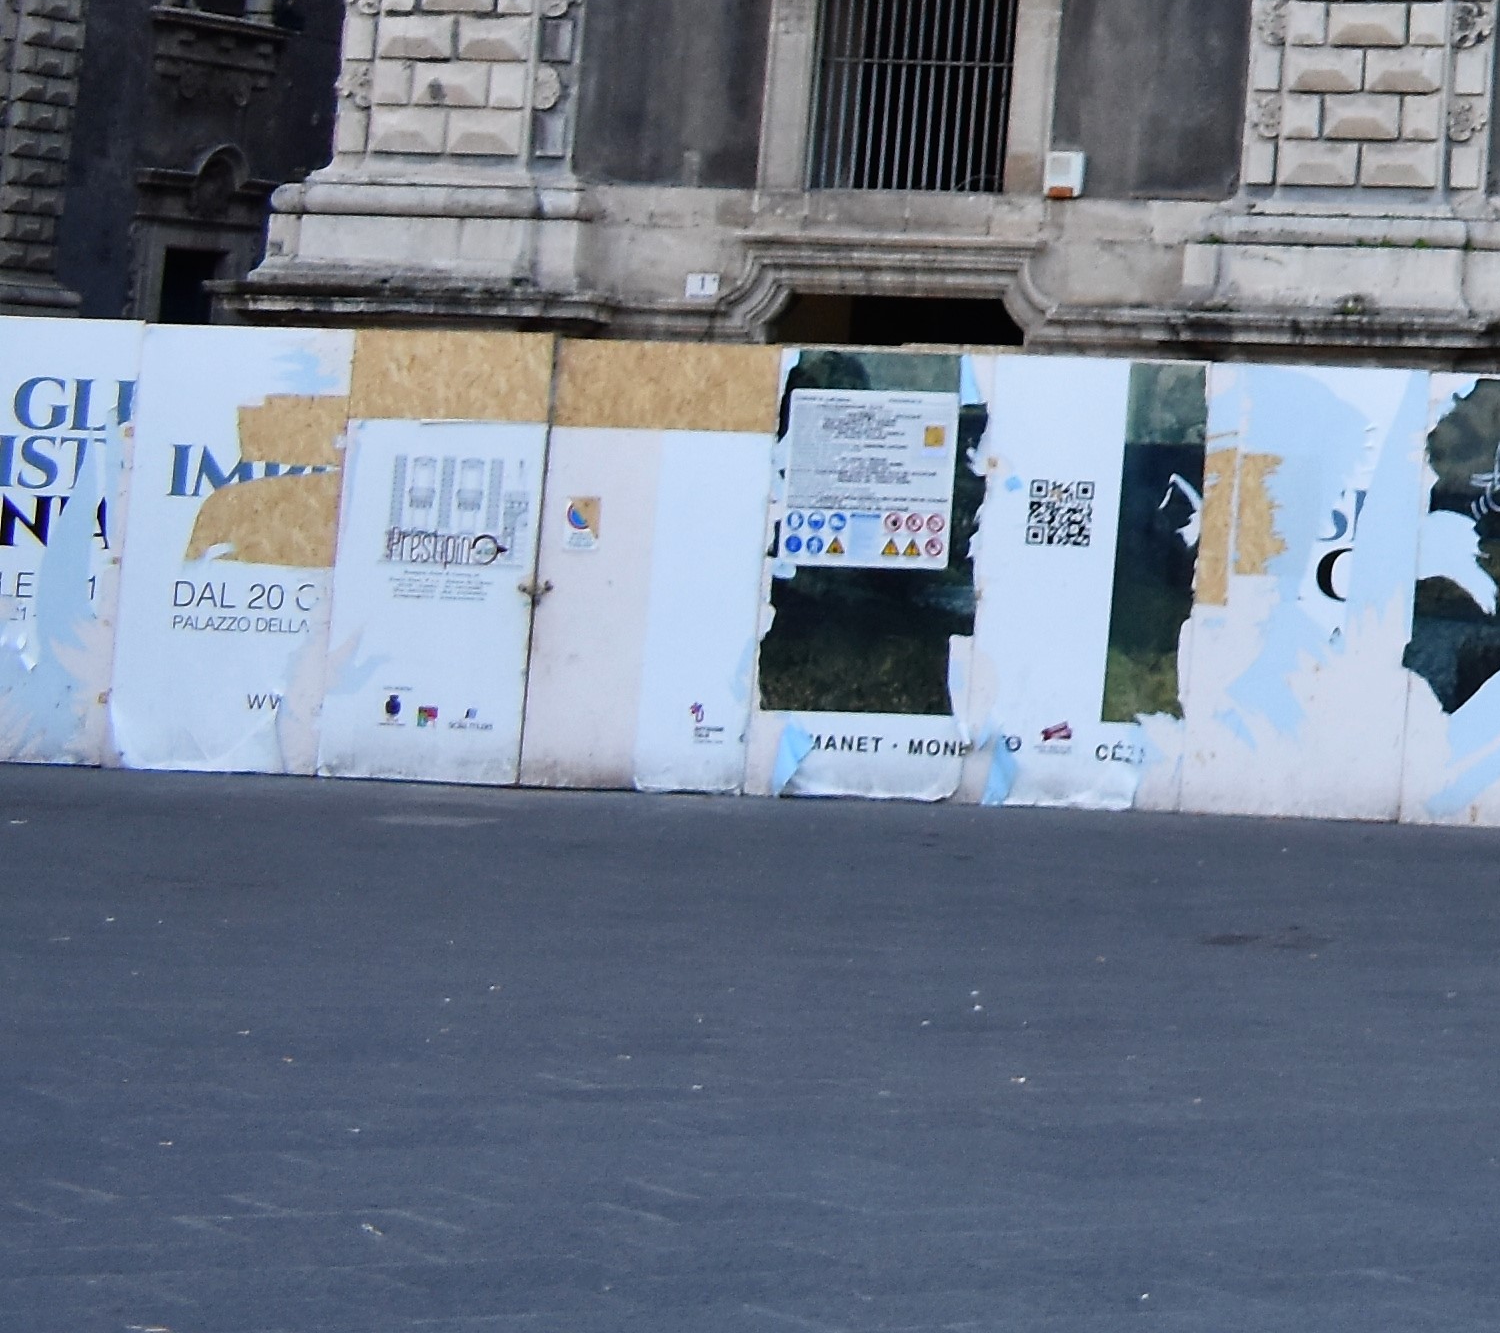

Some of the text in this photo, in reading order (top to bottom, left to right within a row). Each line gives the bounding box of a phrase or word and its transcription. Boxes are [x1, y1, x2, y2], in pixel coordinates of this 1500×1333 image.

[173, 580, 236, 608] DAL
[248, 583, 285, 610] 20
[172, 614, 251, 632] PALAZZO
